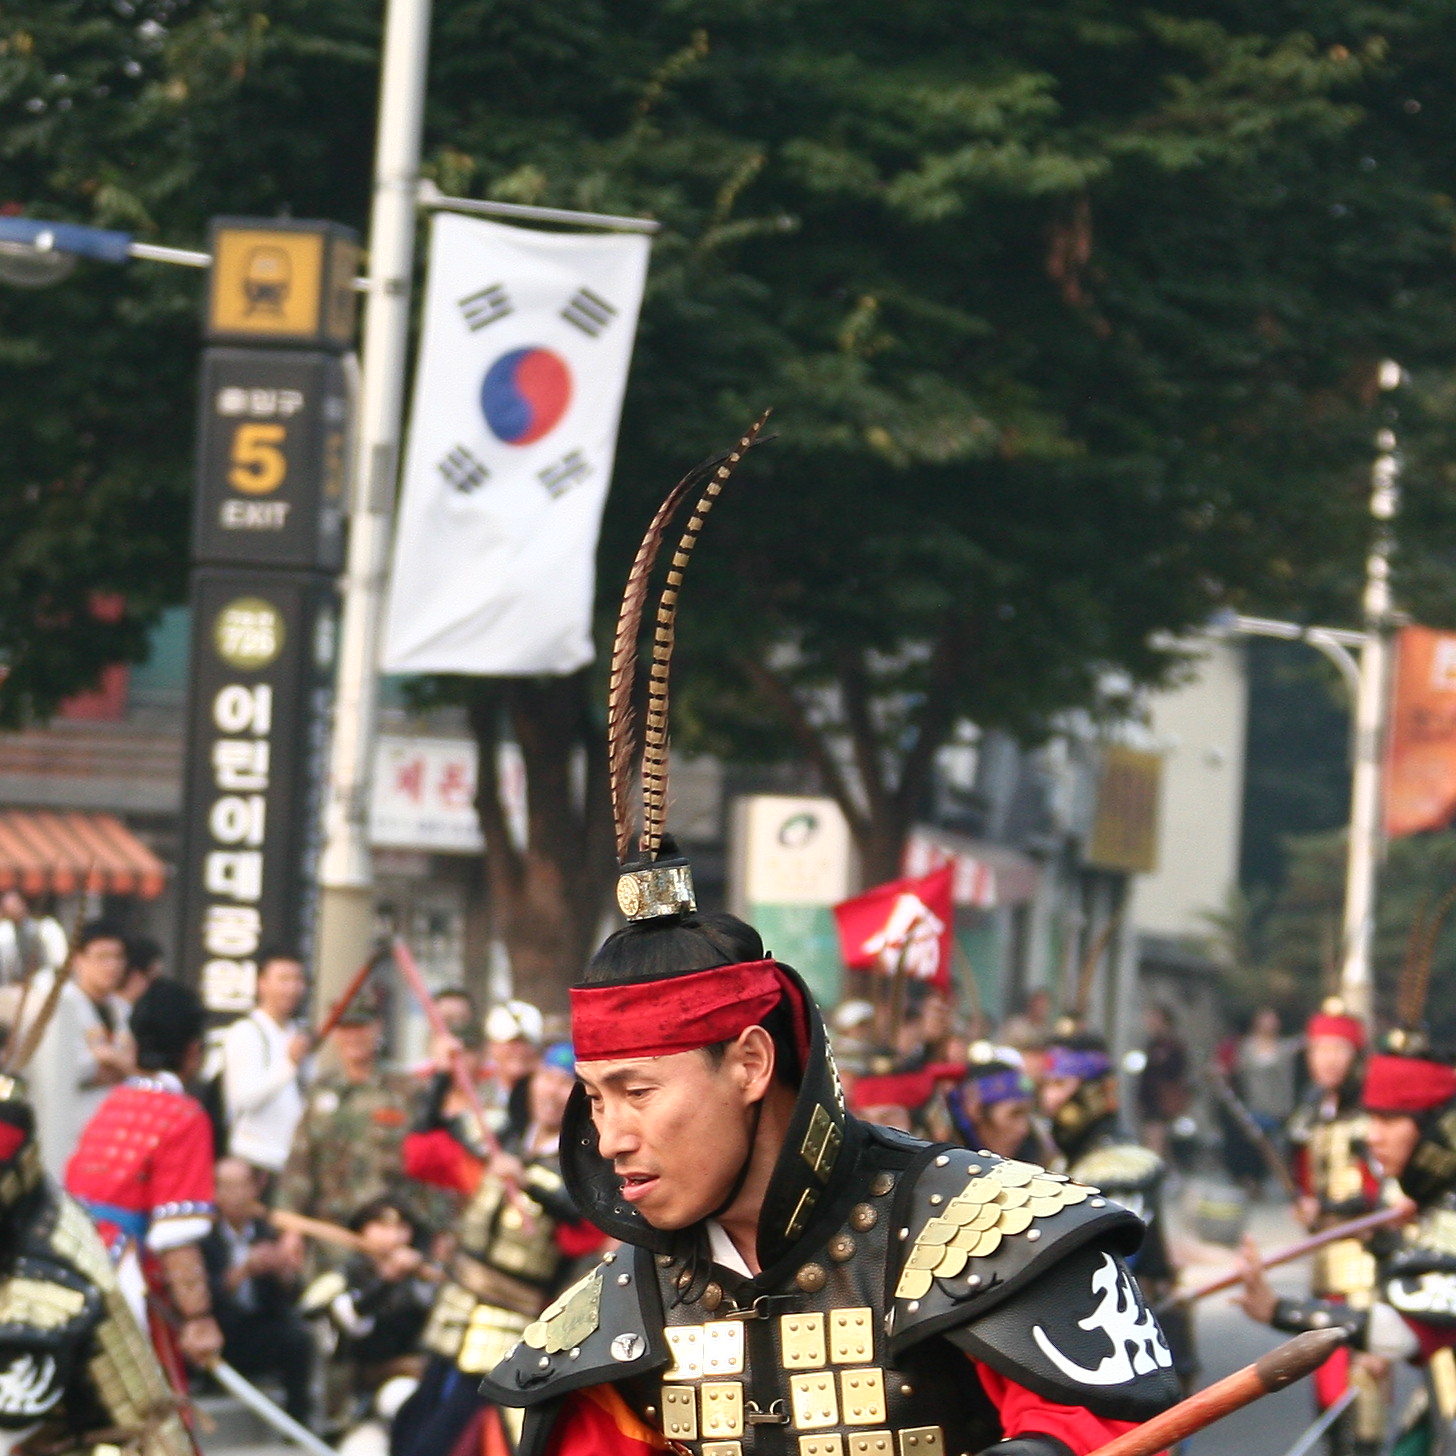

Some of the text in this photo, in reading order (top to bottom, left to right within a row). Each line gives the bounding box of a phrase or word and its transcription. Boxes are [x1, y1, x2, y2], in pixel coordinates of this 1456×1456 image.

[226, 423, 288, 496] 5
[219, 502, 290, 530] EXIT
[199, 682, 274, 1013] 어린이대공원
